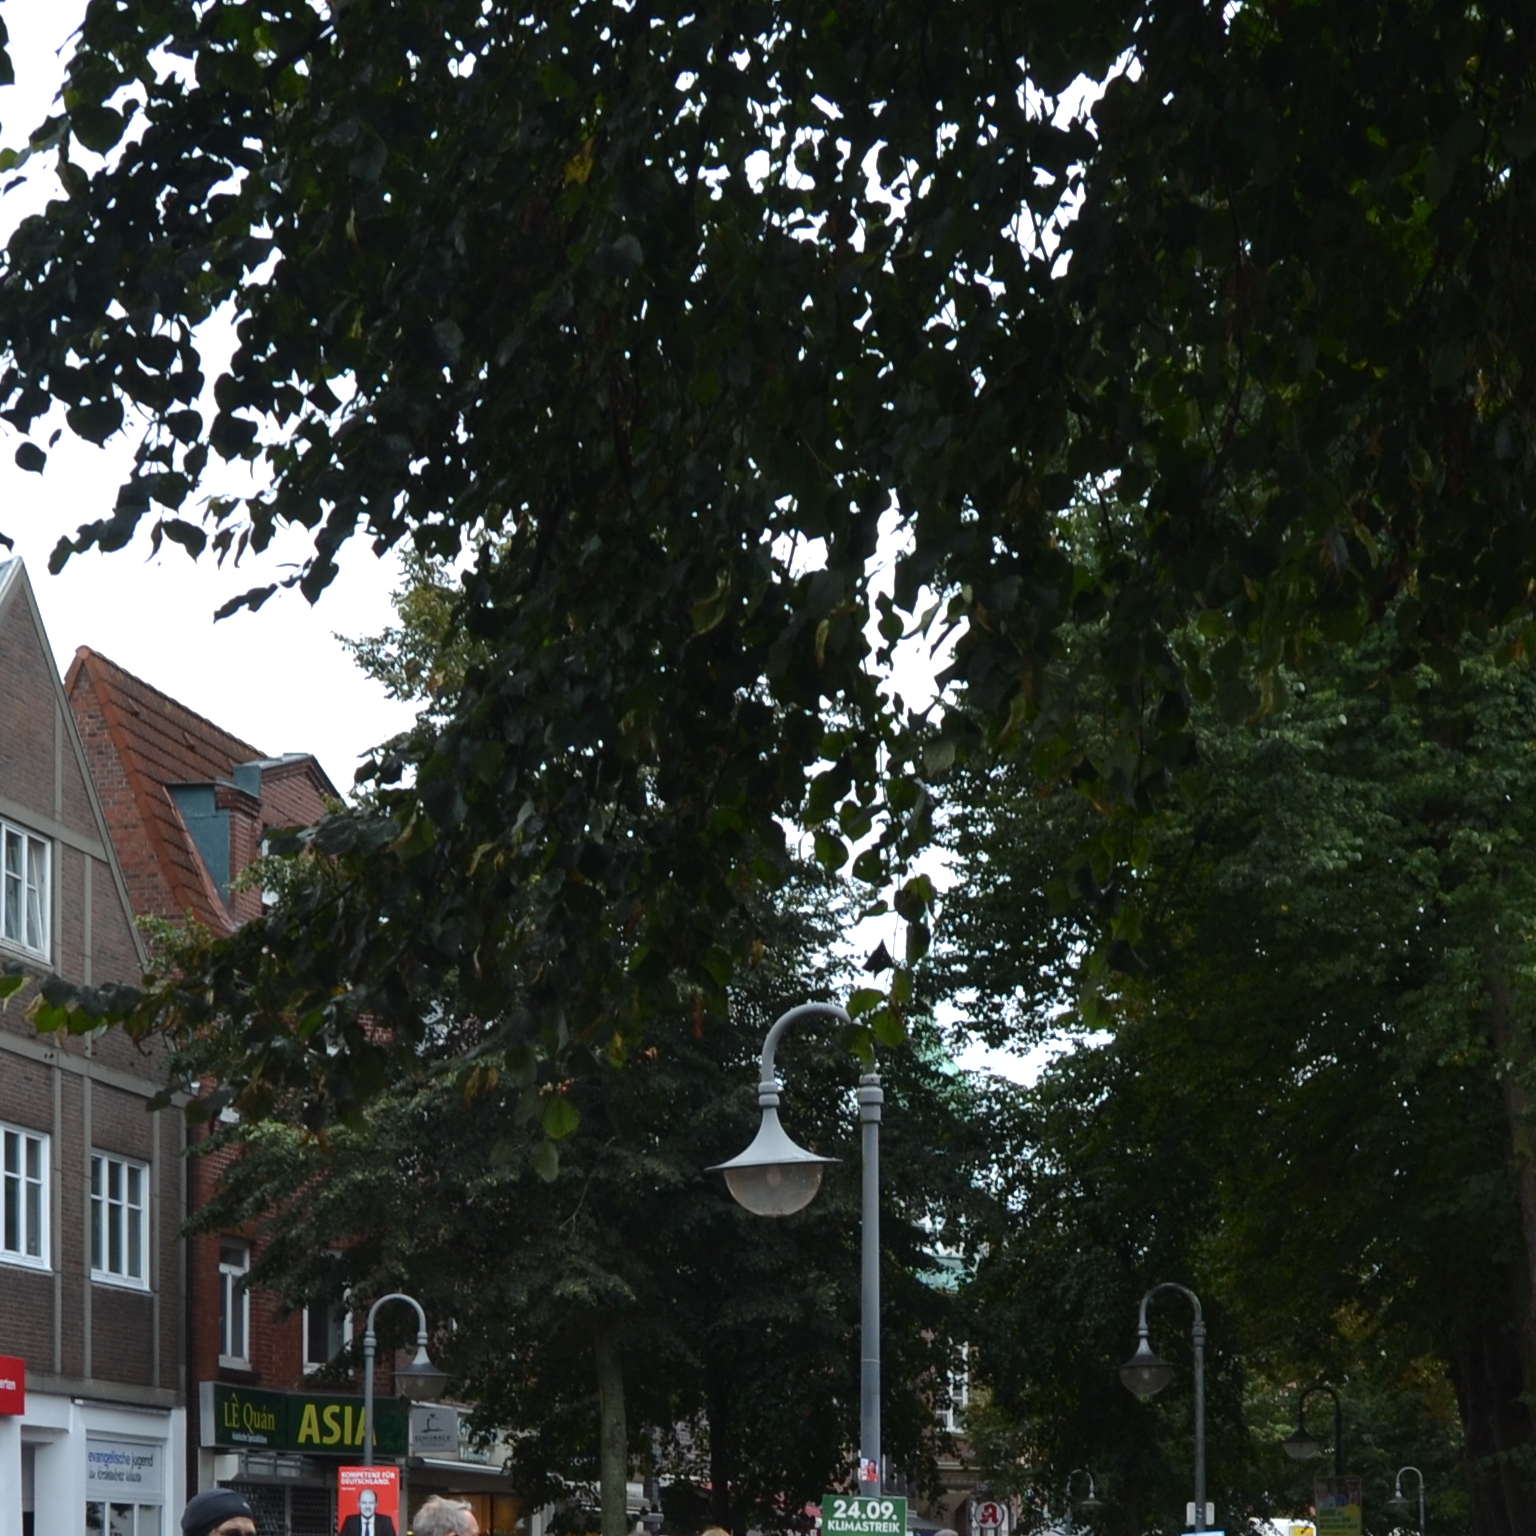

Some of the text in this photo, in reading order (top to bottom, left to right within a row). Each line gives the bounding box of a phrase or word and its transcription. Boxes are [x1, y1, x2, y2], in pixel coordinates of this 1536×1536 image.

[297, 1403, 378, 1447] ASIA
[341, 1470, 395, 1480] KOMPETENZ FÜR
[833, 1500, 898, 1521] 24.09.
[827, 1519, 900, 1534] KLIMASTREIK
